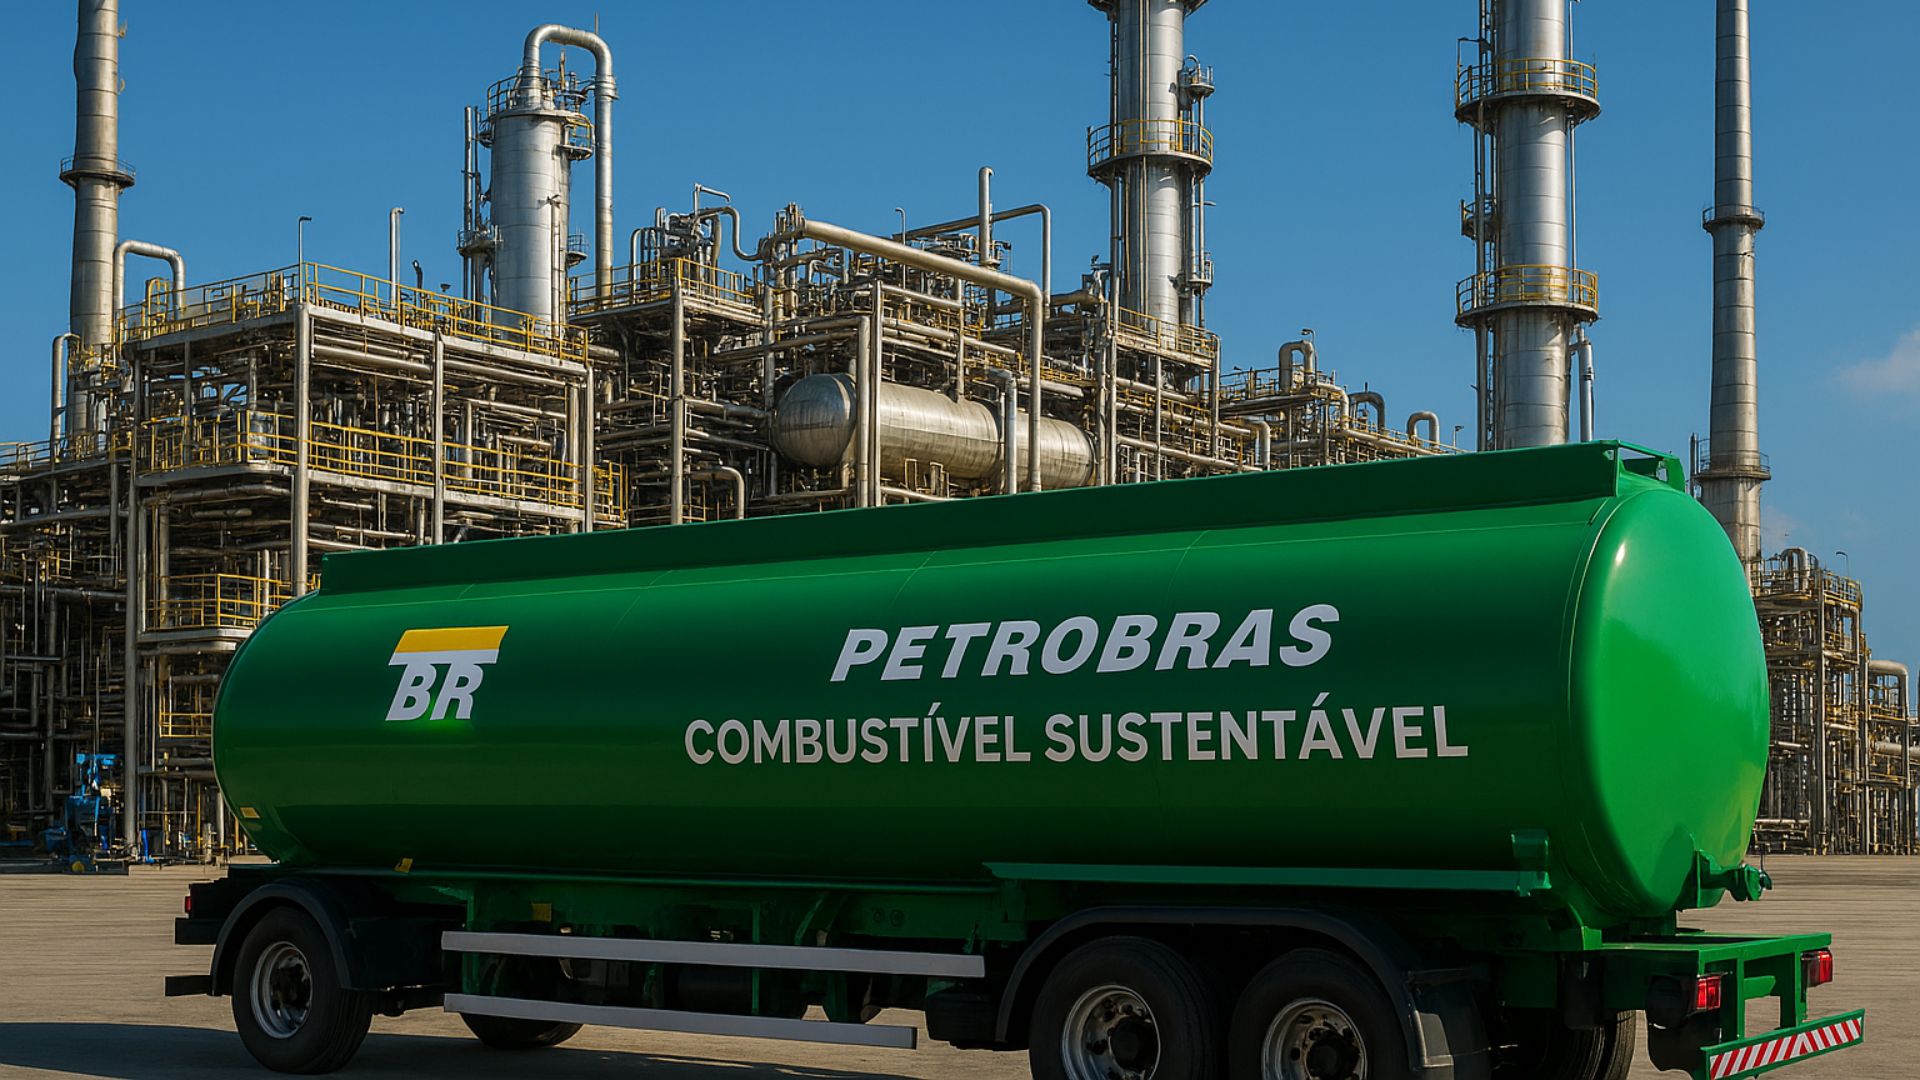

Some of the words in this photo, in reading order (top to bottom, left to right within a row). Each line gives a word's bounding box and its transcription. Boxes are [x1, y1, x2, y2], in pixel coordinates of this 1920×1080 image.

[831, 604, 1340, 682] PETROBRAS
[385, 651, 494, 721] BR
[684, 702, 1031, 765] COMBUSTÍVEL
[1044, 692, 1469, 762] SUSTENTÁVEL
